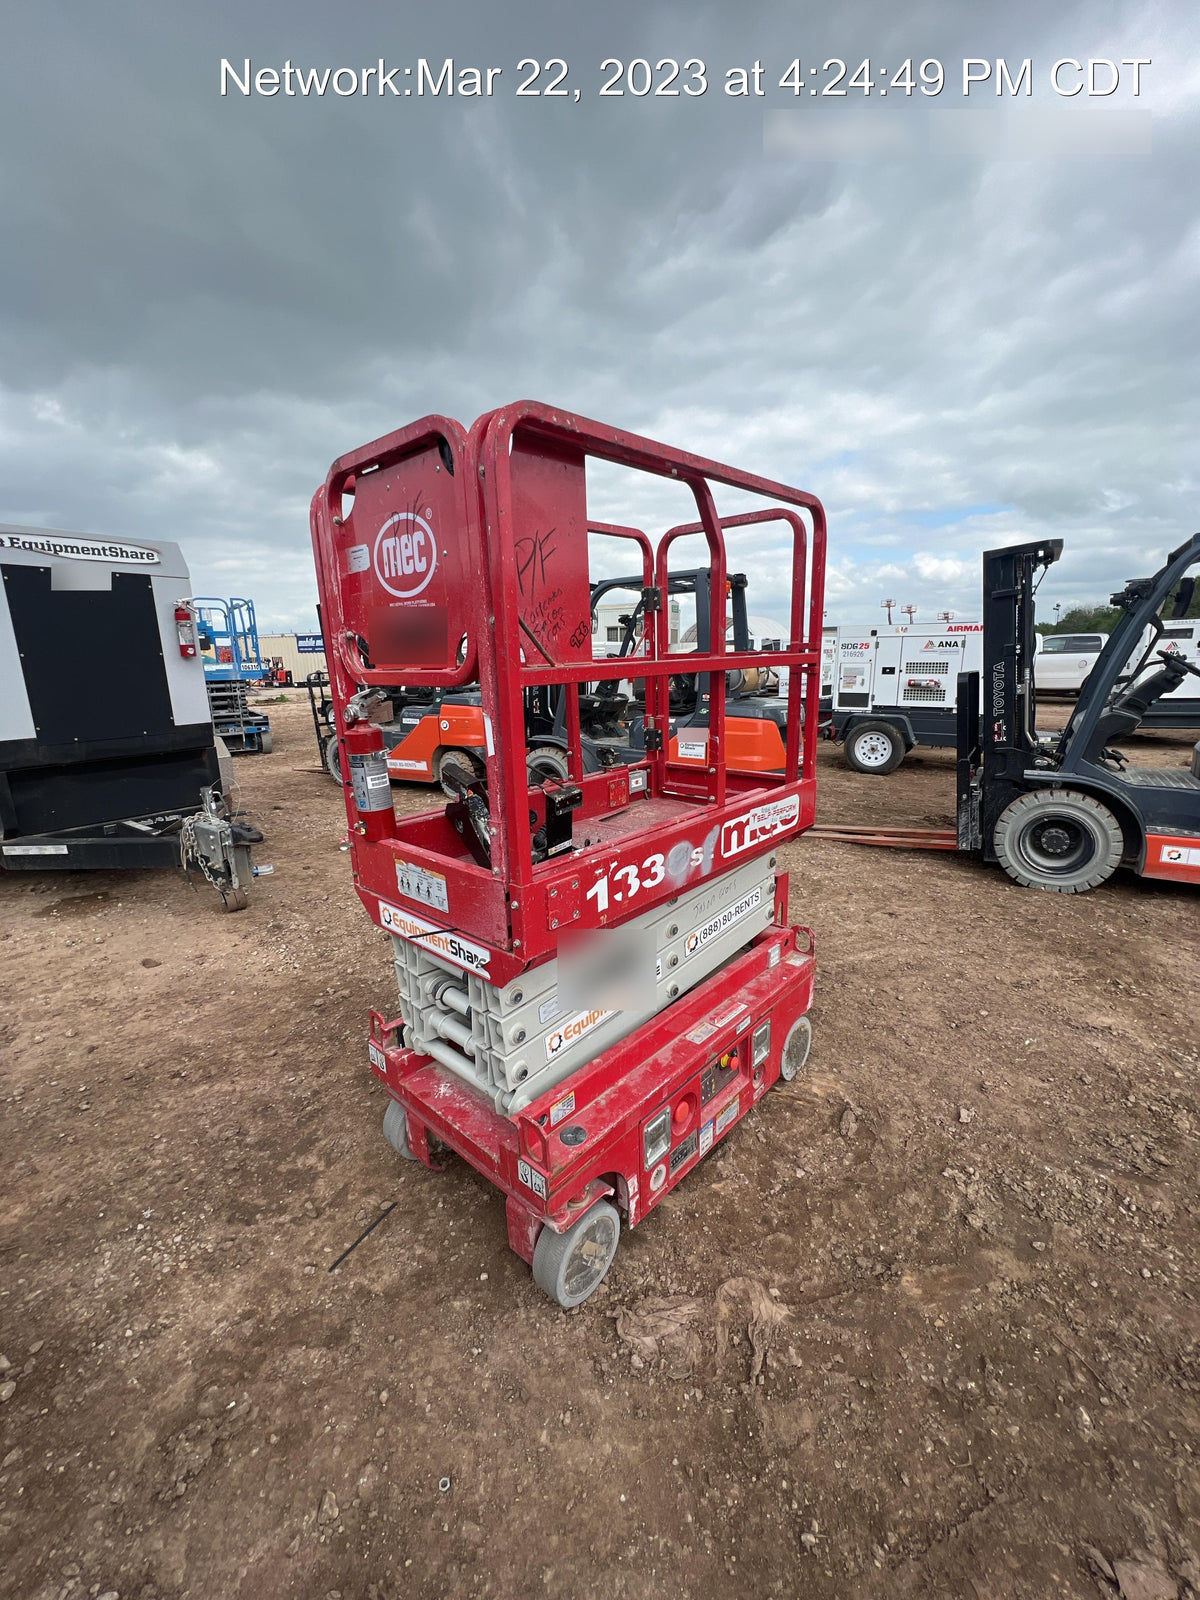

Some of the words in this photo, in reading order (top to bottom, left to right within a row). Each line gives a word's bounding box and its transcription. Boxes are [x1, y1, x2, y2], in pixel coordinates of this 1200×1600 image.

[7, 536, 156, 561] EquipmentShare
[937, 640, 959, 648] ANA
[993, 661, 1005, 717] TOYOTA
[699, 918, 722, 944] (888)
[722, 891, 760, 926] 80-RENTS
